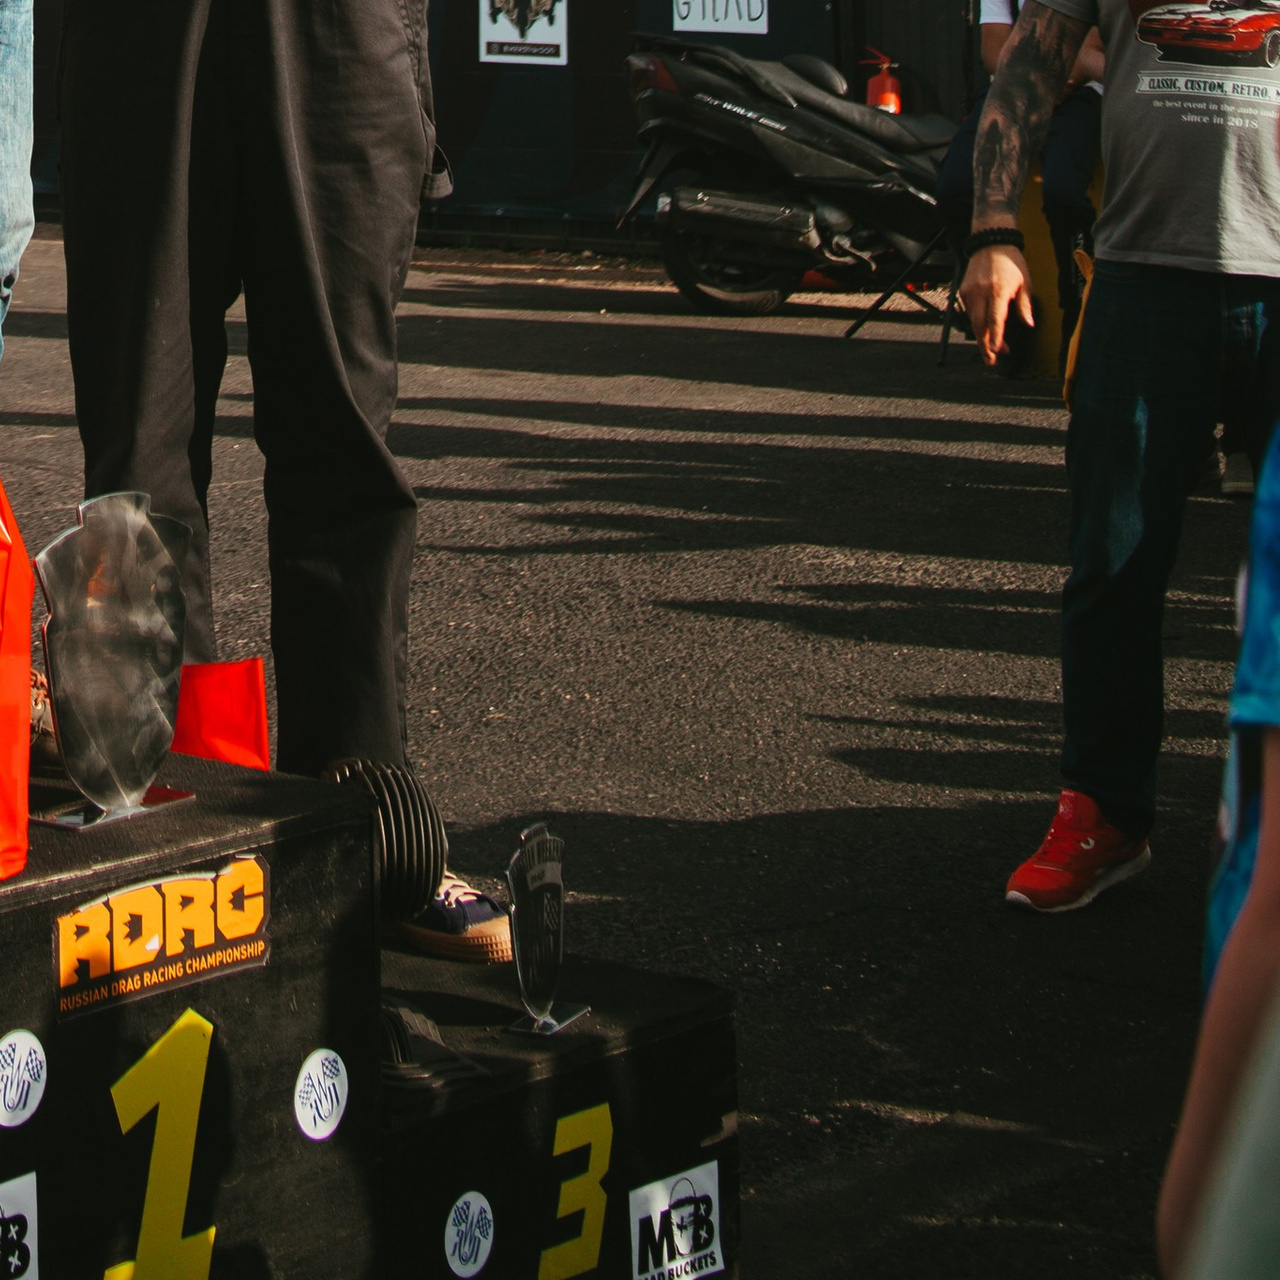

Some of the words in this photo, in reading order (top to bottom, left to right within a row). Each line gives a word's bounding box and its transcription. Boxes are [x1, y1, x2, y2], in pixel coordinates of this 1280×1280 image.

[1181, 113, 1210, 124] since
[1212, 115, 1224, 125] in
[57, 858, 265, 989] RDRC
[59, 984, 109, 1012] RUSSIAN
[111, 976, 142, 996] DRAG
[143, 963, 184, 986] RACING
[185, 940, 266, 974] CHAMPIONSHIP
[104, 1007, 217, 1280] 1
[538, 1101, 614, 1280] 3
